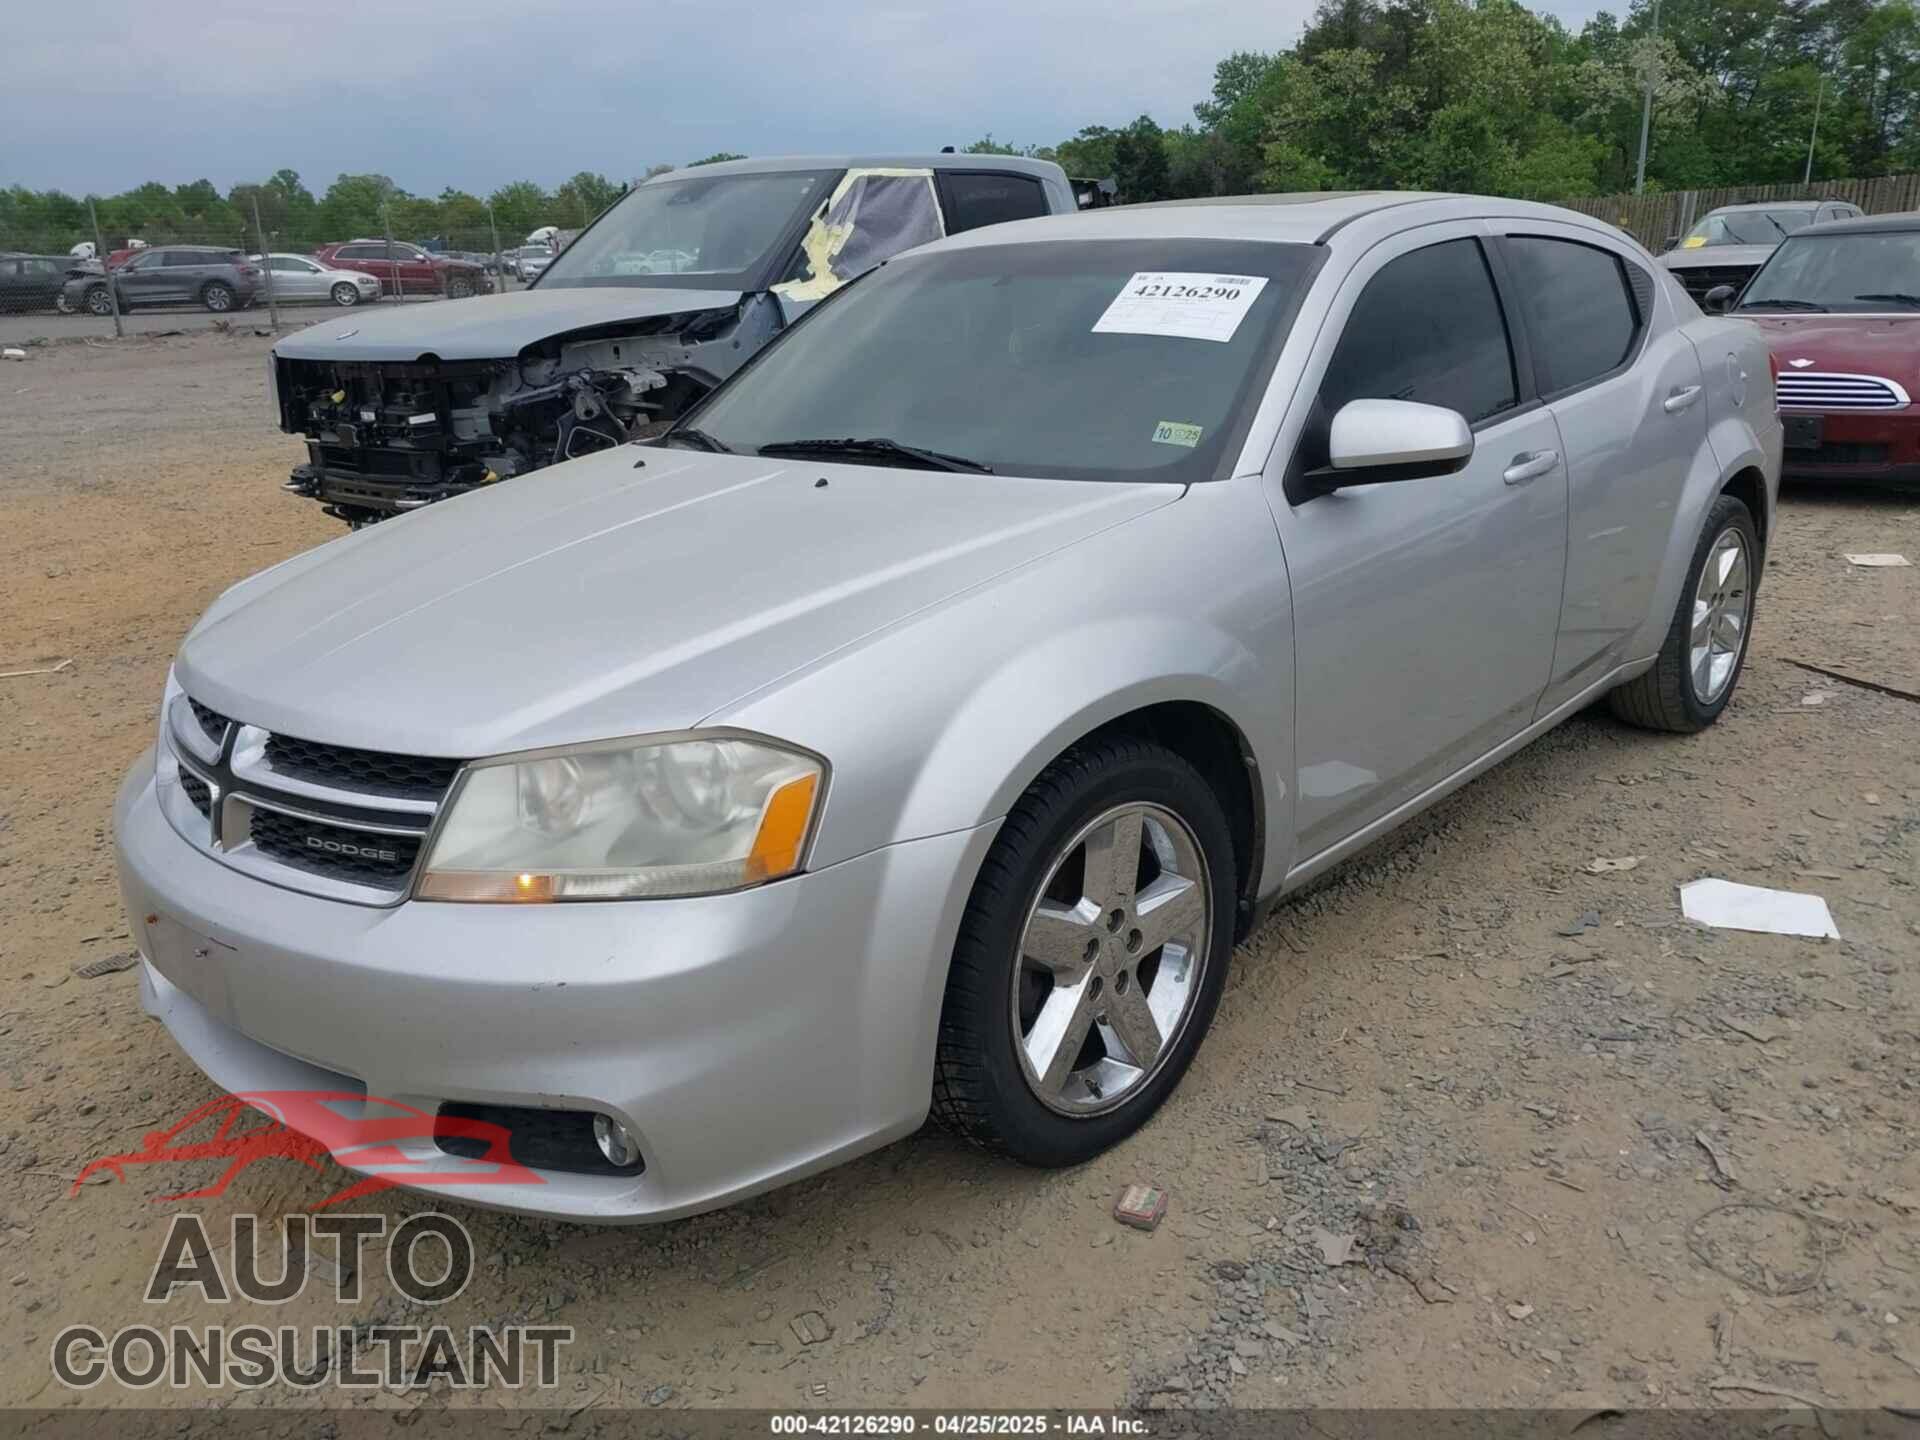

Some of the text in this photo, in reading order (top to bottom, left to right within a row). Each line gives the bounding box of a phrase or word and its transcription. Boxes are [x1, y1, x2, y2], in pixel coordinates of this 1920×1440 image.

[1134, 285, 1241, 301] 42126290
[1159, 426, 1172, 440] 10
[307, 837, 396, 861] DODGE
